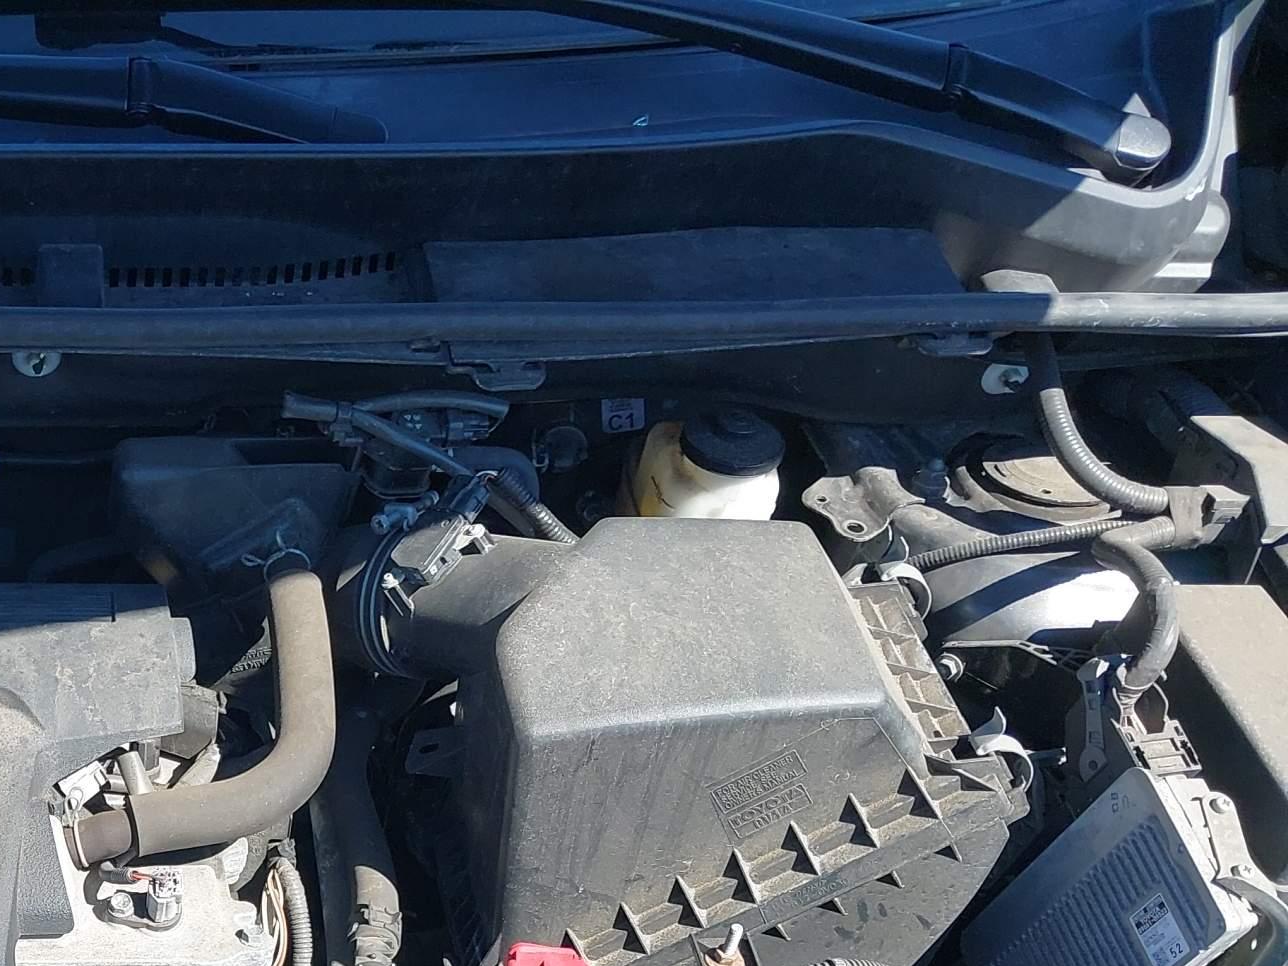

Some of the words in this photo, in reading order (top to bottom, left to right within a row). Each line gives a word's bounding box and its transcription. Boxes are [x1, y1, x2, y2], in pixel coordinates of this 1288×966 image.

[608, 412, 634, 431] C1
[716, 783, 737, 797] FOR
[736, 775, 753, 788] AIR
[752, 755, 793, 780] CLEANER
[721, 780, 758, 803] SERVICE
[760, 771, 778, 784] SEE
[764, 769, 800, 792] MANUAL
[729, 785, 805, 826] TOYOTA
[1169, 942, 1184, 959] 52
